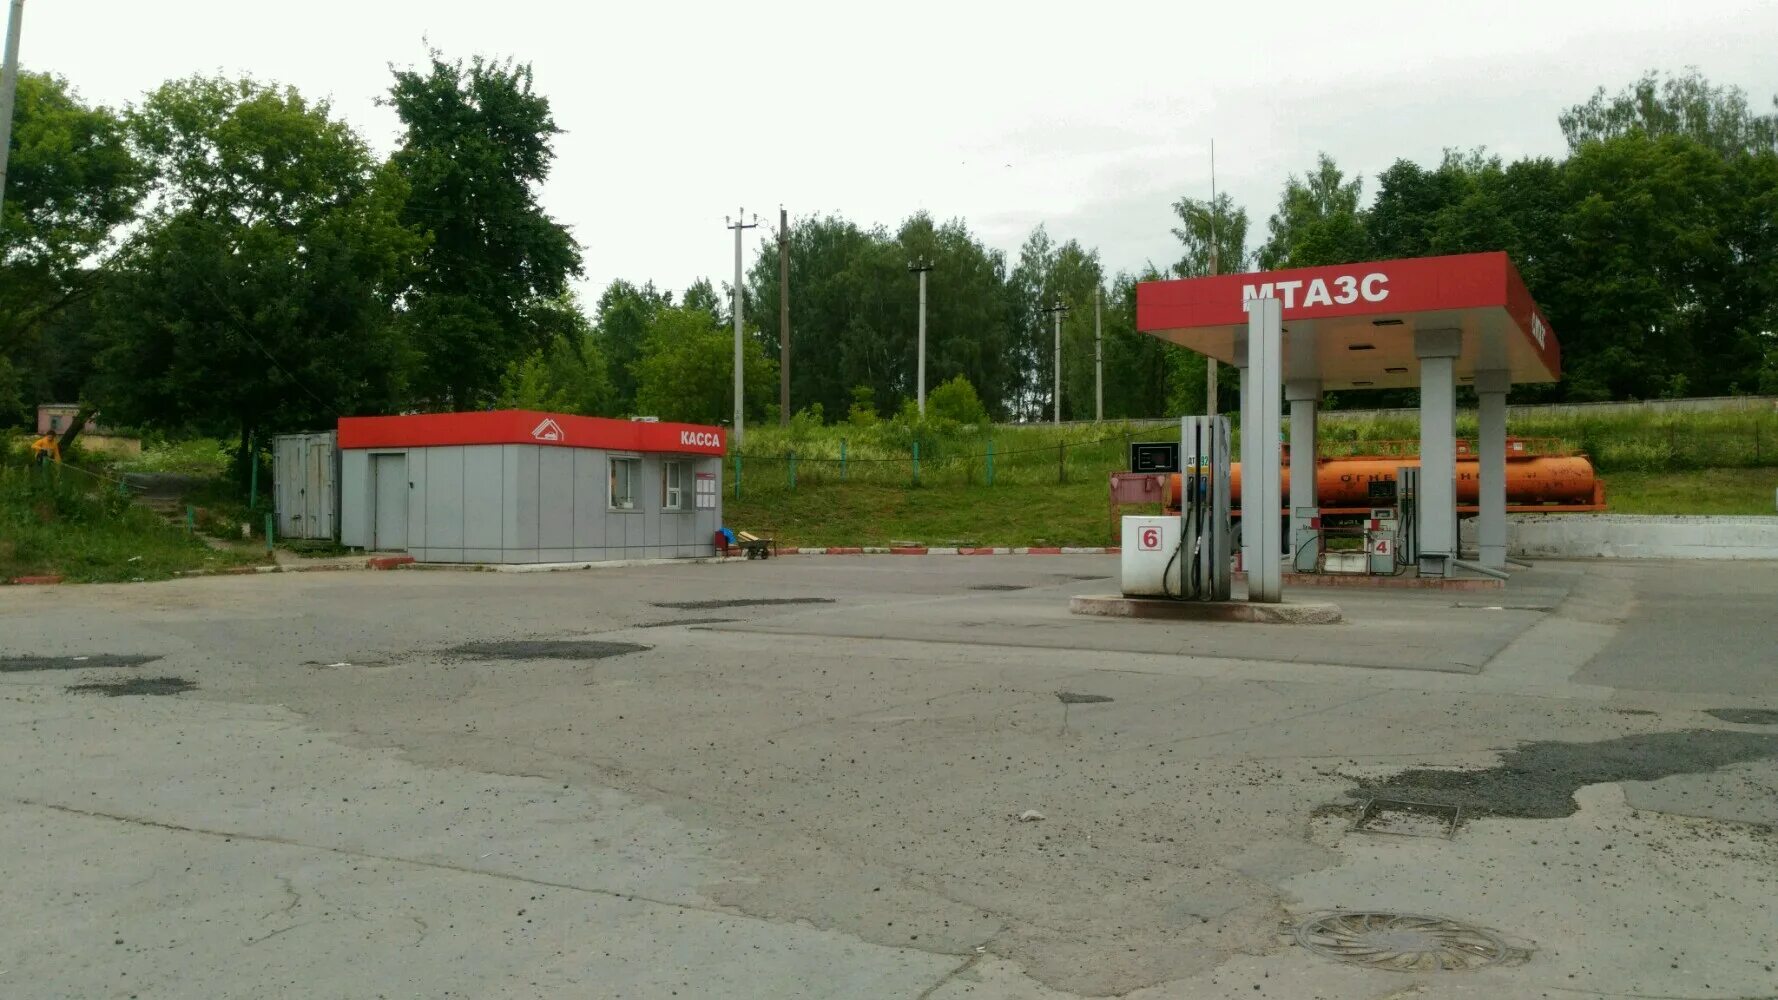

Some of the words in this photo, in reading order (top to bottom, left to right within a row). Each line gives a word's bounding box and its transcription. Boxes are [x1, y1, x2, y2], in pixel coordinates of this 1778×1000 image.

[1242, 272, 1390, 313] МТАЗС
[680, 430, 720, 448] КАССА
[1143, 528, 1158, 548] 6
[1376, 541, 1388, 554] 4
